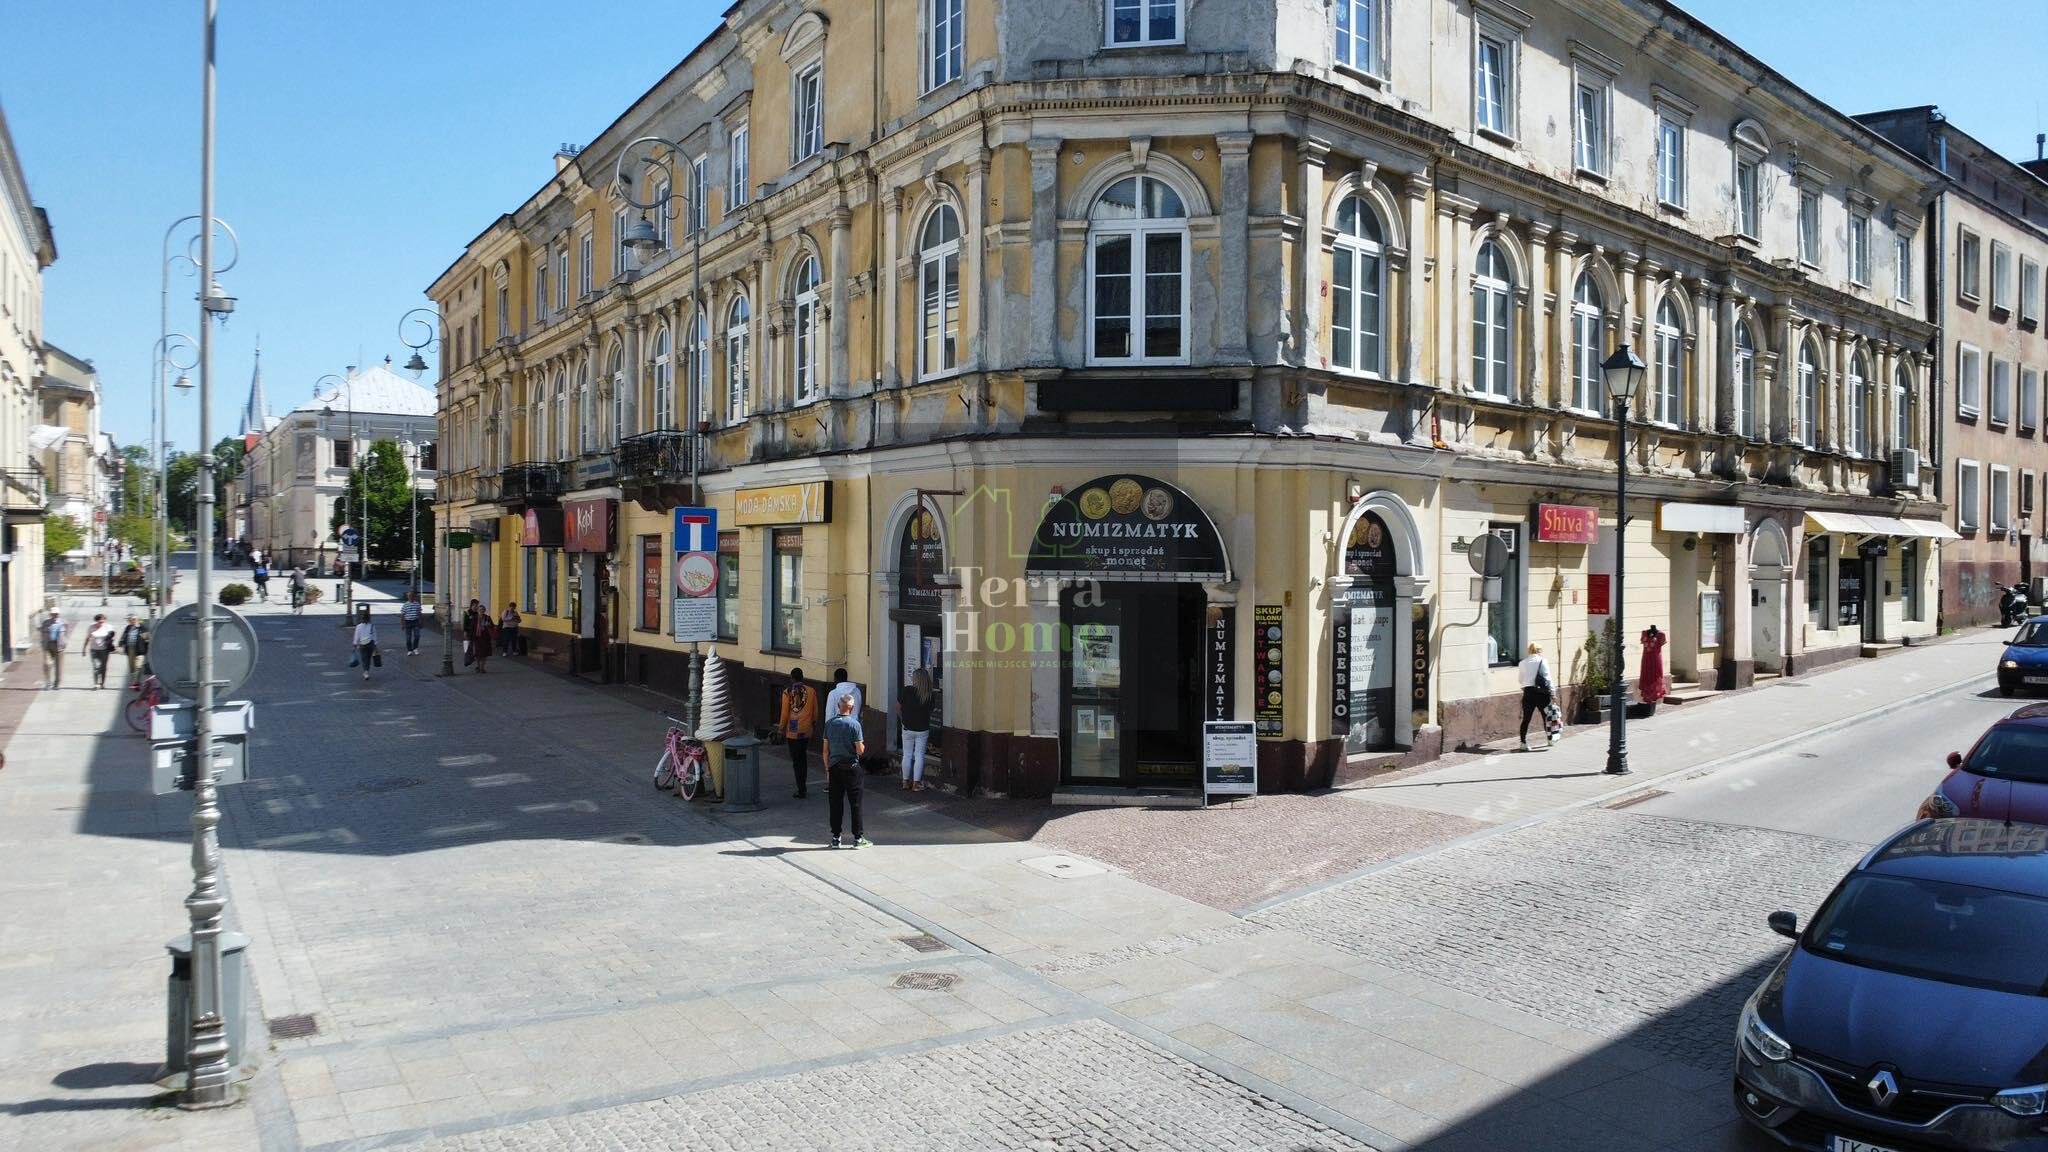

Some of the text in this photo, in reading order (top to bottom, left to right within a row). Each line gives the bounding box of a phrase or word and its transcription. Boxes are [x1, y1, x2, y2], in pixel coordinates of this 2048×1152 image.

[737, 483, 824, 523] MODA DAMSKA XL
[1052, 522, 1199, 538] NUMIZMATYK
[1544, 509, 1583, 532] Shiva
[1086, 545, 1165, 556] skup i sprzedaż
[1106, 557, 1147, 566] monet
[1255, 607, 1281, 615] SKUP
[1214, 619, 1227, 722] NUMIZMATY
[1334, 626, 1347, 716] SREBRO
[1414, 629, 1426, 699] ZŁOTO
